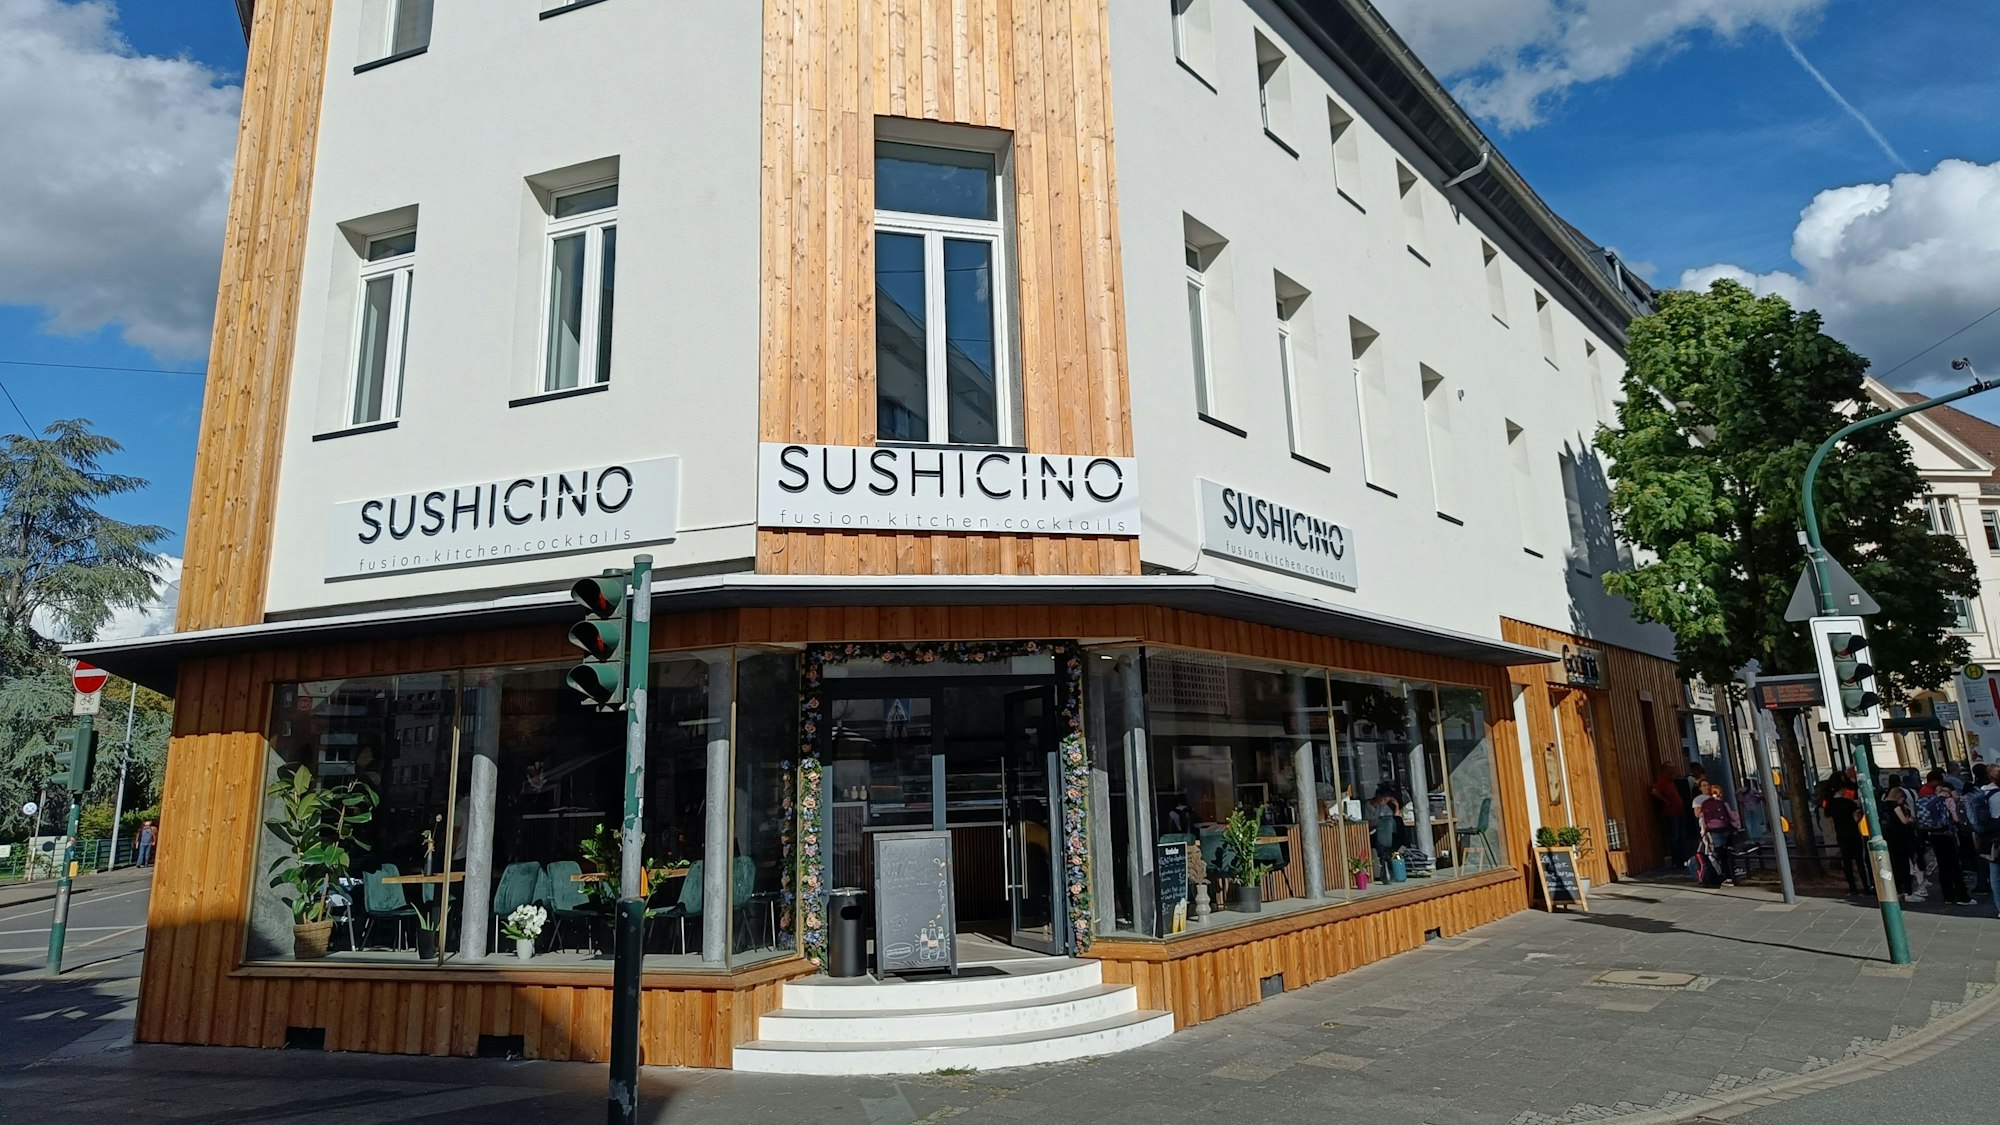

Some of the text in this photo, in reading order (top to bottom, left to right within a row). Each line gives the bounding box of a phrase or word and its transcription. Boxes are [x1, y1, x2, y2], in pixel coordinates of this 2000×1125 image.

[358, 465, 634, 545] SUSHICINO
[778, 446, 1123, 502] SUSHICINO
[1222, 487, 1344, 561] SUSHICINO
